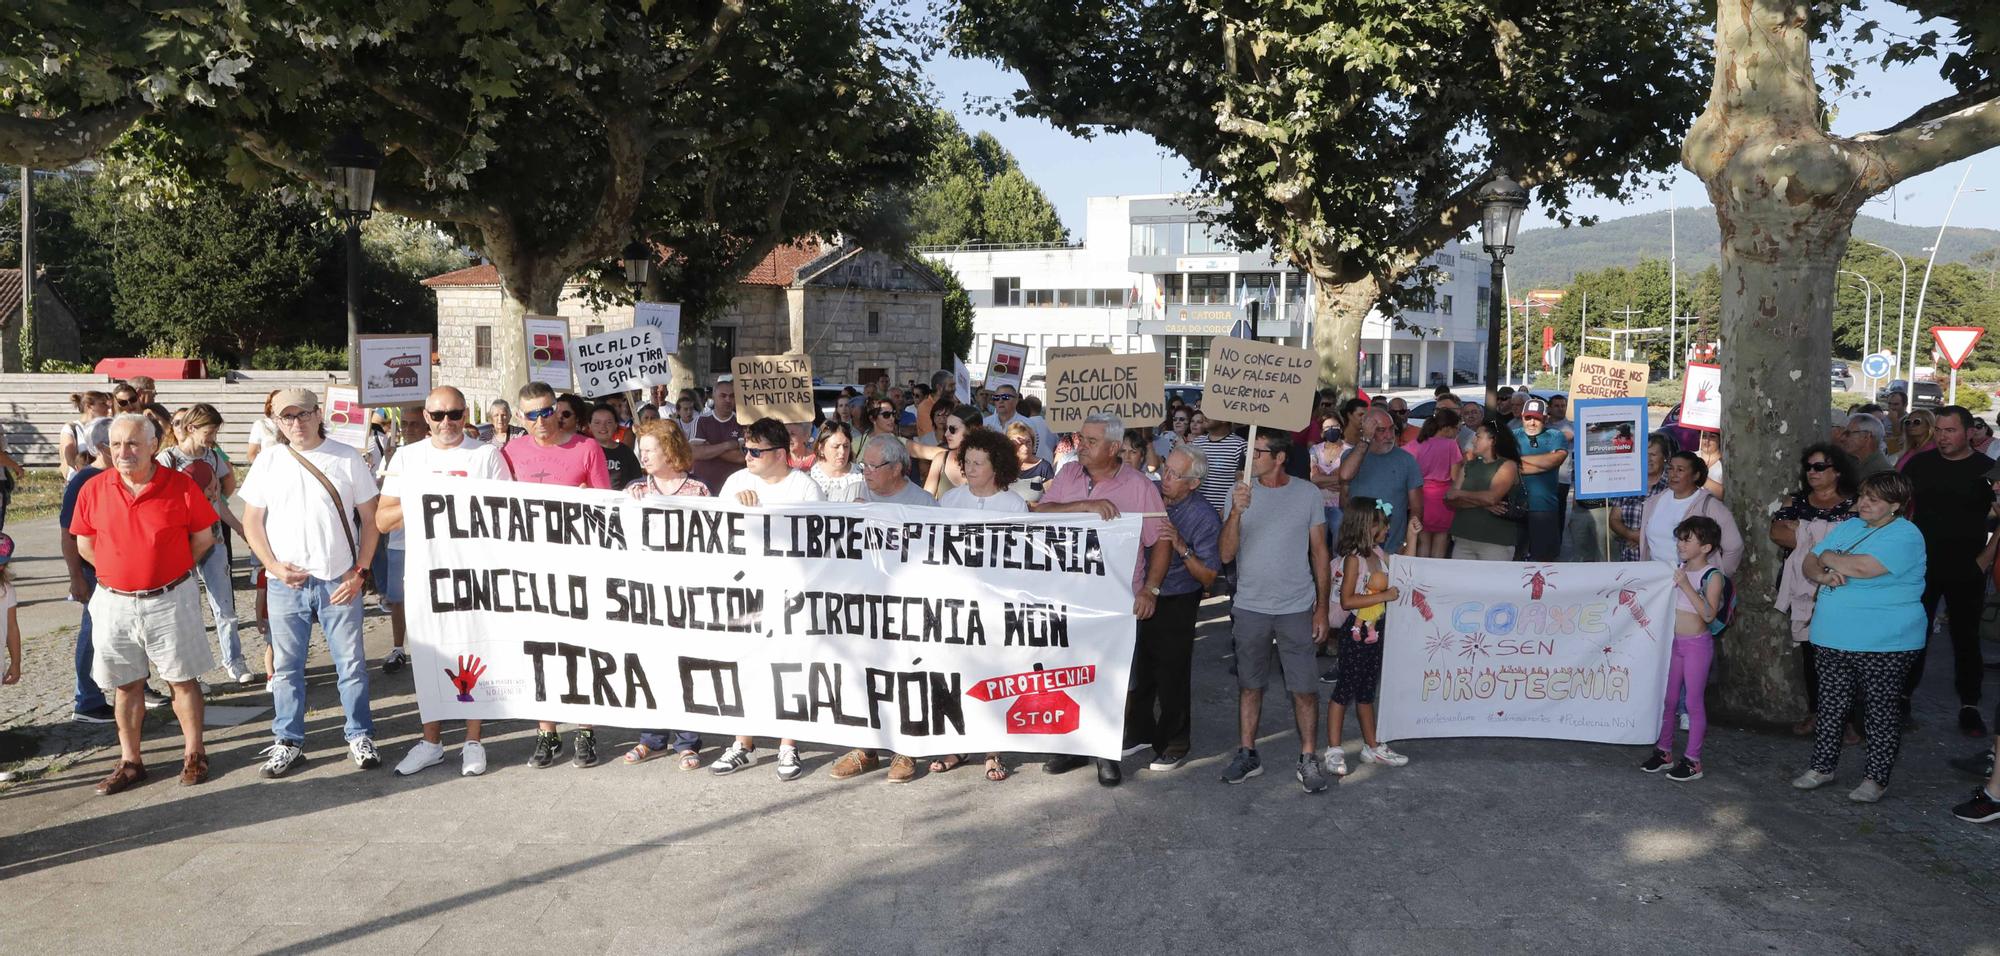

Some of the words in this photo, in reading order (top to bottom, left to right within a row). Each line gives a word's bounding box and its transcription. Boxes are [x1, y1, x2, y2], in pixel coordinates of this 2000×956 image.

[1192, 310, 1232, 320] CATOIRA
[579, 332, 651, 357] ALCALDE
[580, 353, 633, 374] TOUZÓN
[1220, 348, 1239, 362] NO
[739, 361, 773, 374] DIMO
[776, 360, 807, 373] ESTA
[1058, 367, 1138, 385] ALCALDE
[1213, 364, 1241, 379] HAY
[1243, 370, 1301, 384] FALSEDAD
[1579, 362, 1606, 375] HASTA
[1609, 367, 1626, 379] QUE
[1629, 371, 1644, 383] NOS
[394, 376, 416, 385] STOP
[740, 377, 787, 391] FARTO
[792, 376, 810, 389] DE
[743, 392, 811, 406] MENTIRAS
[1055, 383, 1137, 403] SOLUCION
[1212, 384, 1275, 398] QUEREMOS
[1280, 393, 1289, 403] A
[1576, 383, 1629, 398] SEGUIREMOS
[1050, 407, 1082, 422] TIRA
[1223, 399, 1270, 413] VERDAD
[422, 494, 627, 551] PLATAFORMA
[642, 508, 746, 555] COAXE
[763, 514, 864, 560] LIBRE
[865, 527, 899, 550] DE
[900, 522, 1106, 576] PIROTECNIA
[428, 568, 589, 620] CONCELLO
[606, 570, 773, 638] SOLUCIÓN,
[785, 589, 986, 645] PIROTECNIA
[1004, 602, 1069, 647] NON
[1451, 602, 1609, 635] COAXE
[1495, 639, 1556, 655] SEN
[523, 640, 657, 710] TIRA
[771, 657, 966, 736] GALPÓN
[985, 665, 1091, 700] PIROTECNIA
[1421, 667, 1630, 701] PIROTECNIA
[1012, 709, 1064, 727] STOP
